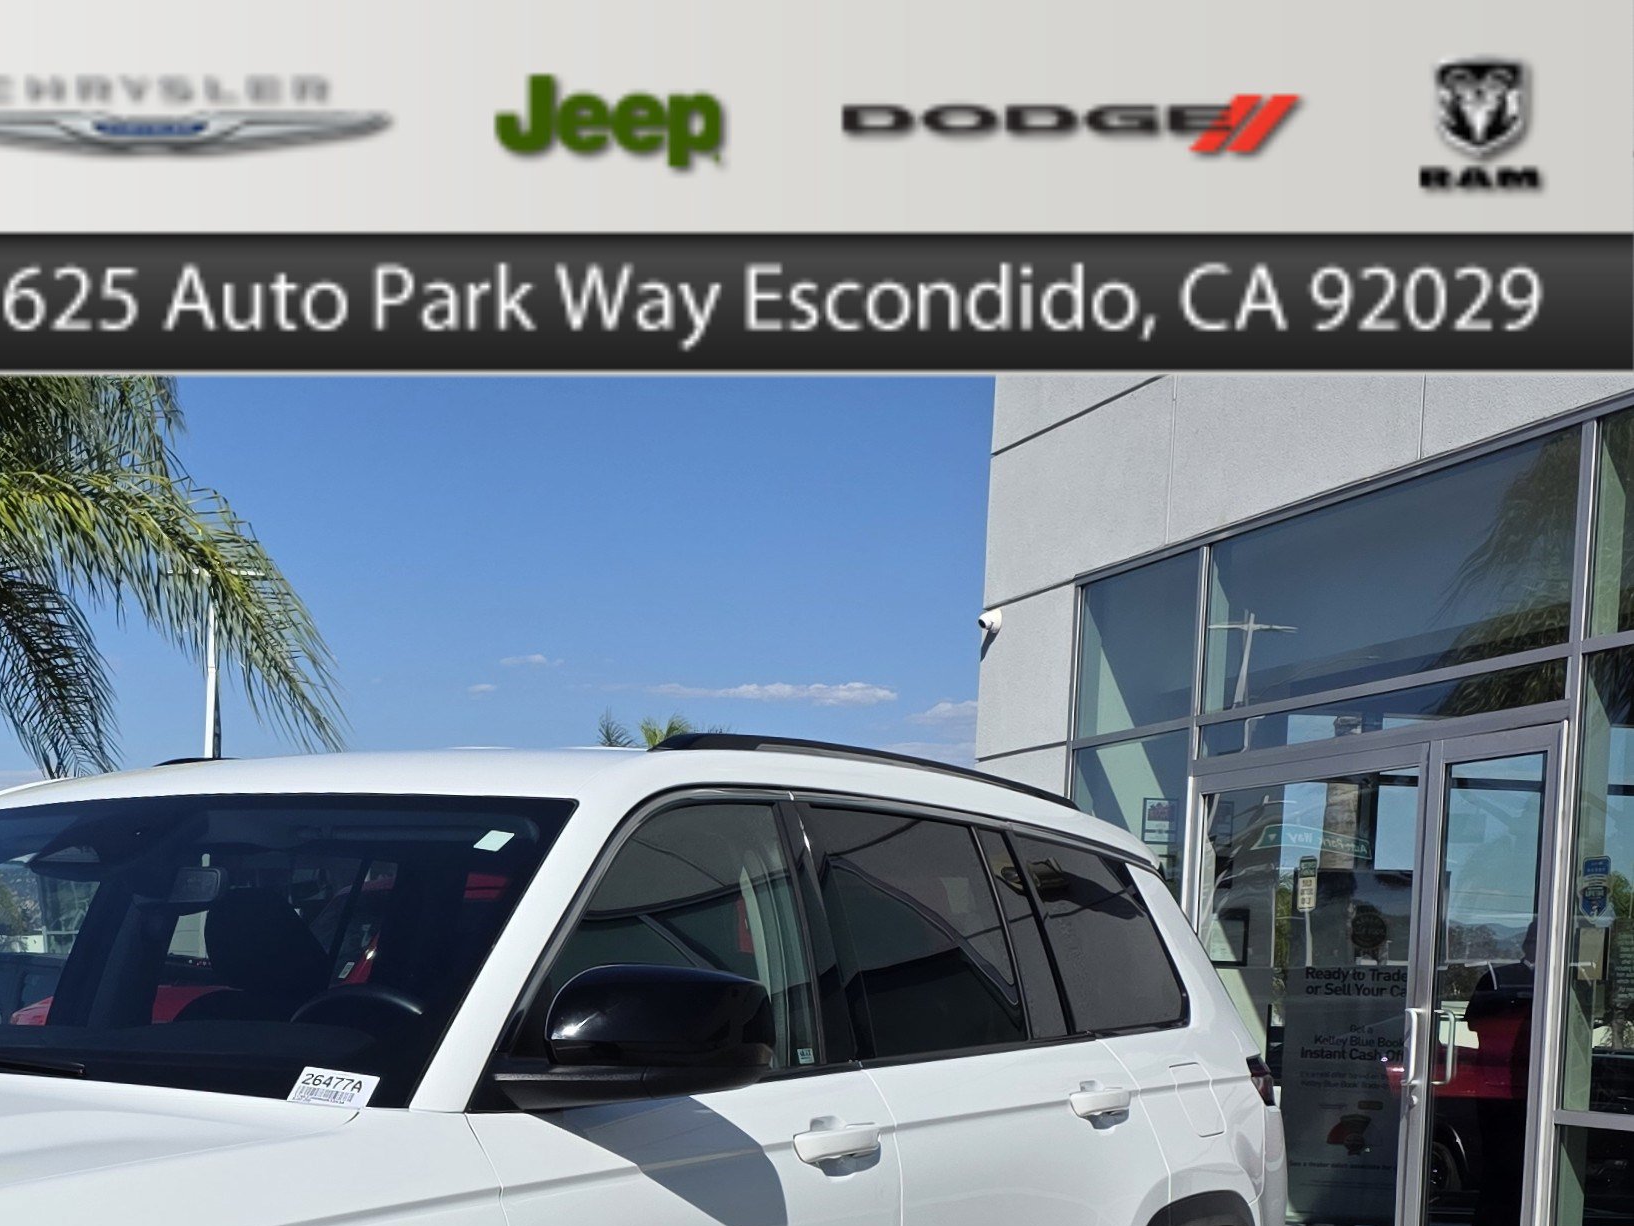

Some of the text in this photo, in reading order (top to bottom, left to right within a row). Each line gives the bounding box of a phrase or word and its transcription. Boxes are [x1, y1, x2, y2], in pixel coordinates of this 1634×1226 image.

[1306, 967, 1349, 982] Ready
[1306, 985, 1321, 995] or
[1324, 983, 1351, 996] Sell
[1355, 984, 1387, 996] Your
[1300, 1046, 1346, 1059] Instant
[1349, 1048, 1382, 1060] Cash
[302, 1073, 363, 1093] 26477A
